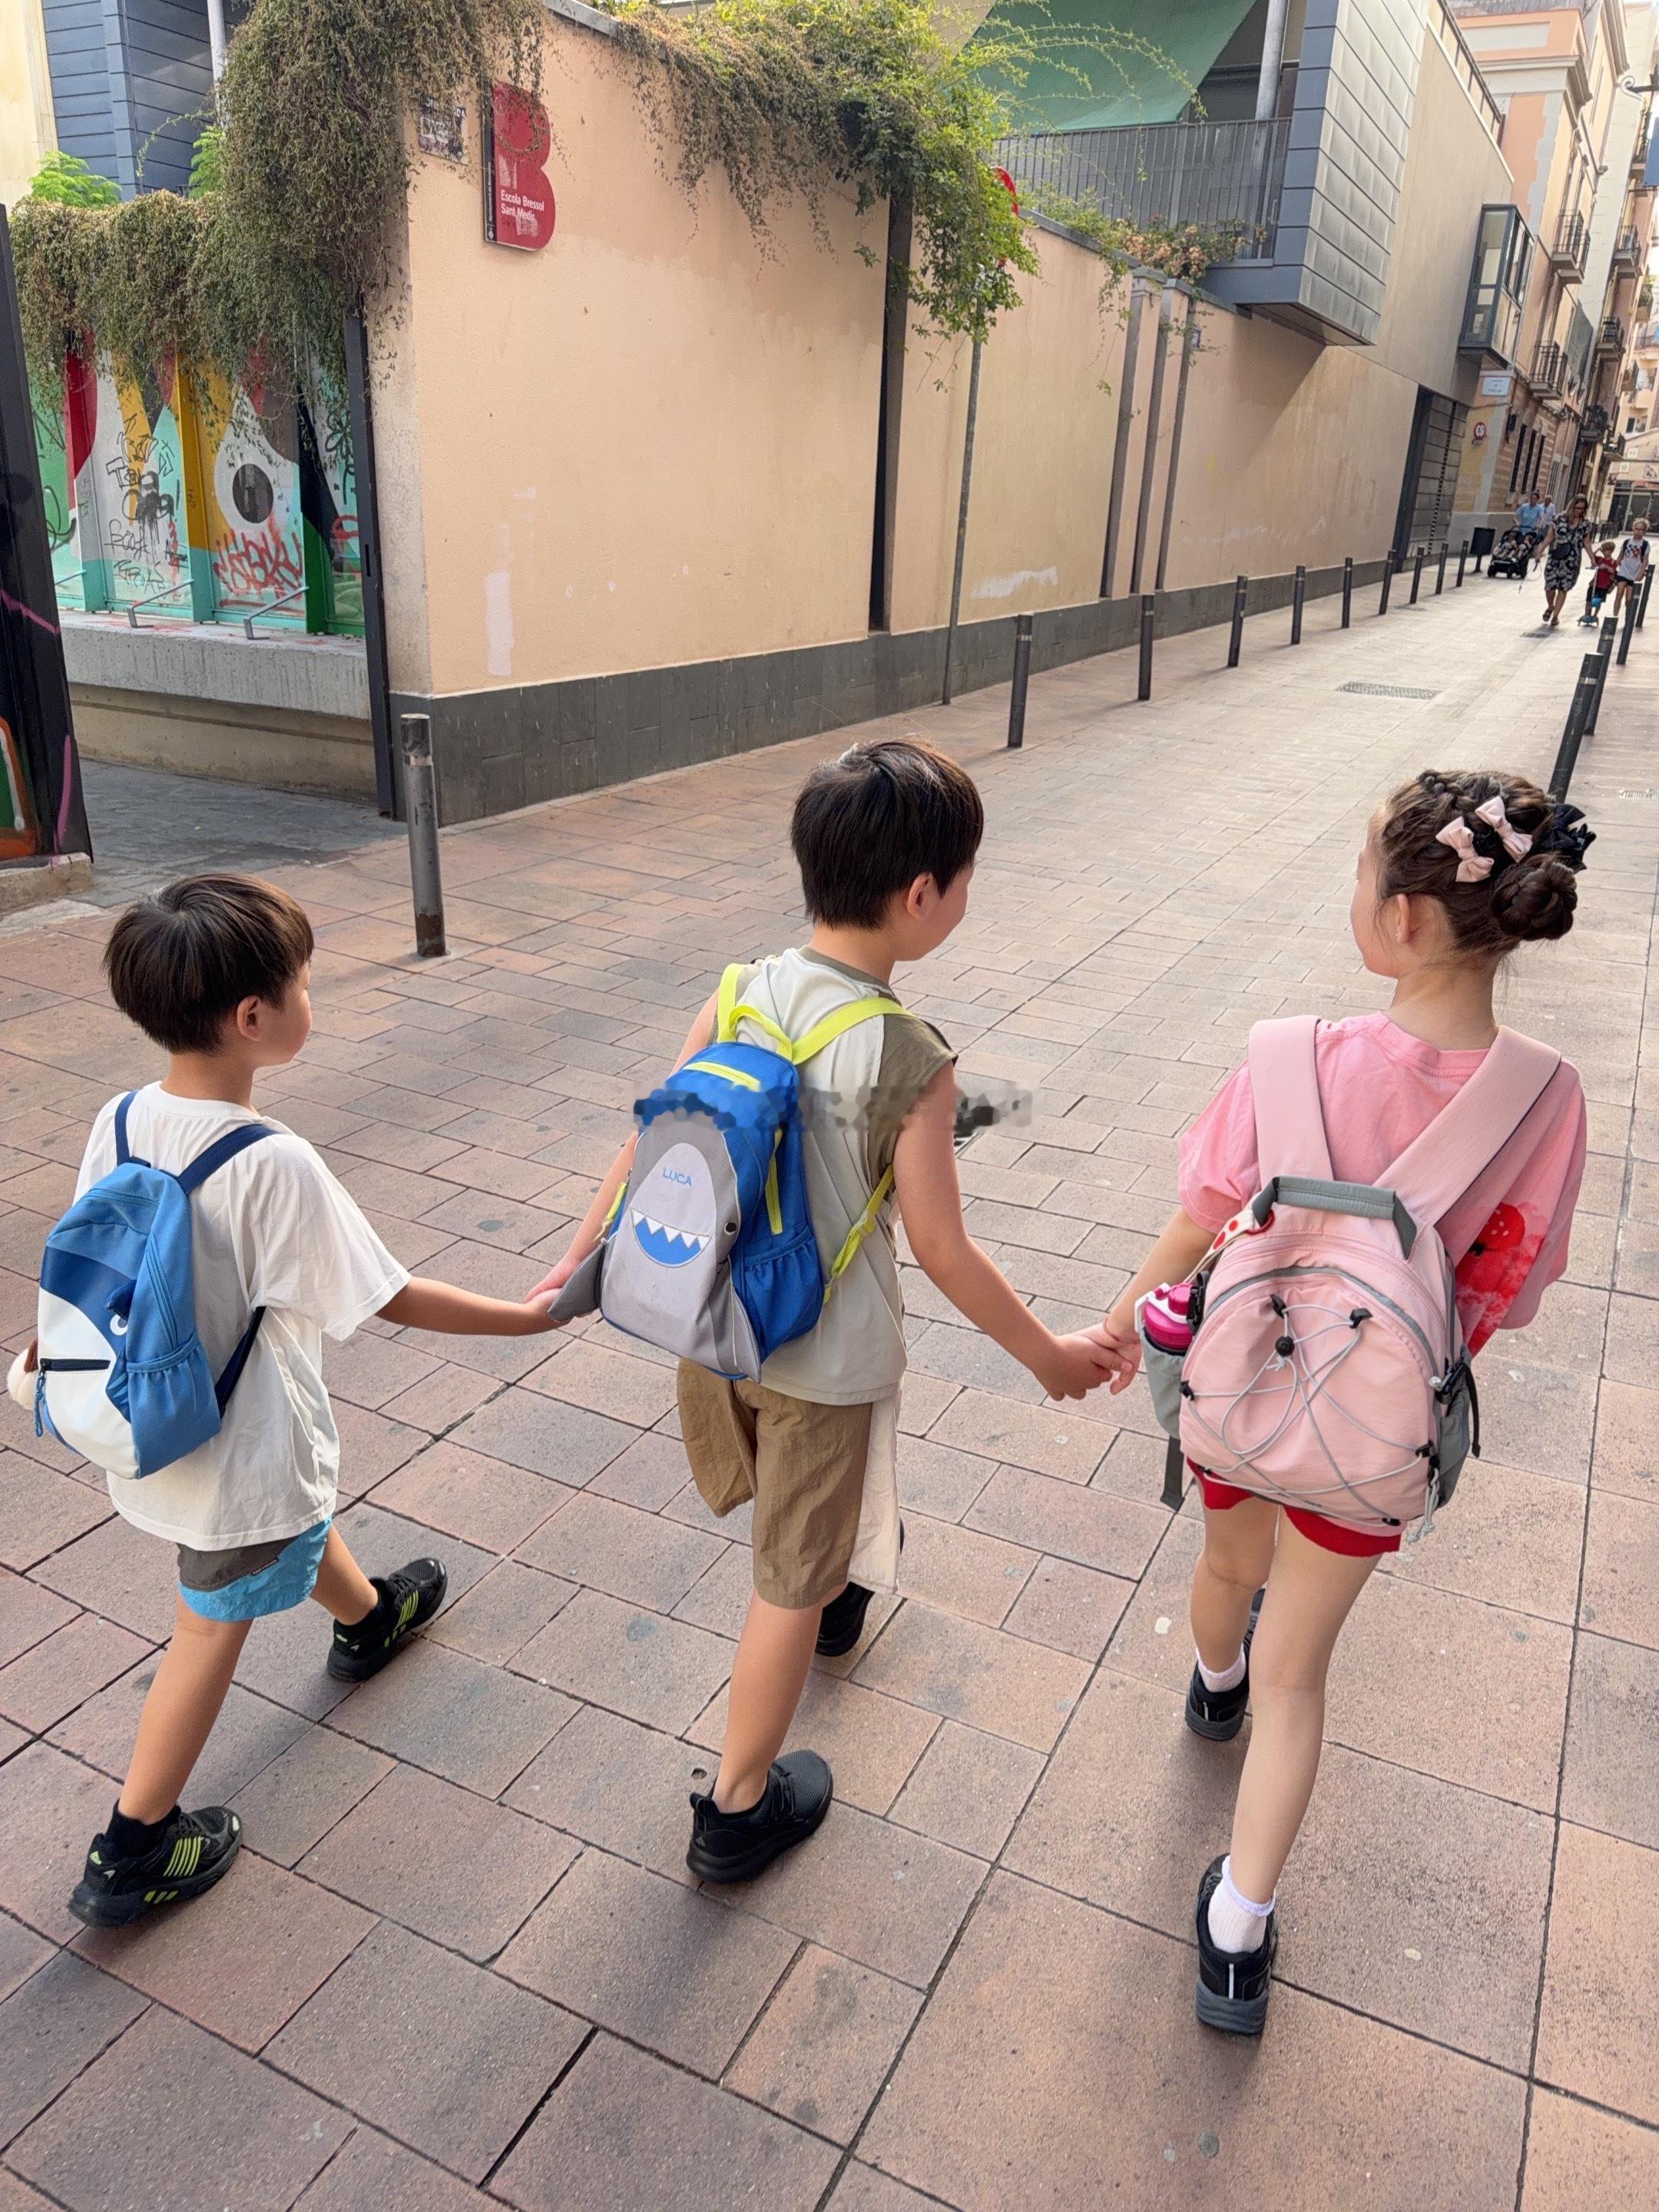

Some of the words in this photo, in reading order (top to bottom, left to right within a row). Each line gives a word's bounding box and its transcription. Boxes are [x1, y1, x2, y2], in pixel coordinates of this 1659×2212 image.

[501, 189, 521, 205] Escola
[522, 195, 545, 212] Bressol
[501, 203, 515, 216] Sant
[663, 1167, 692, 1187] LUCA
